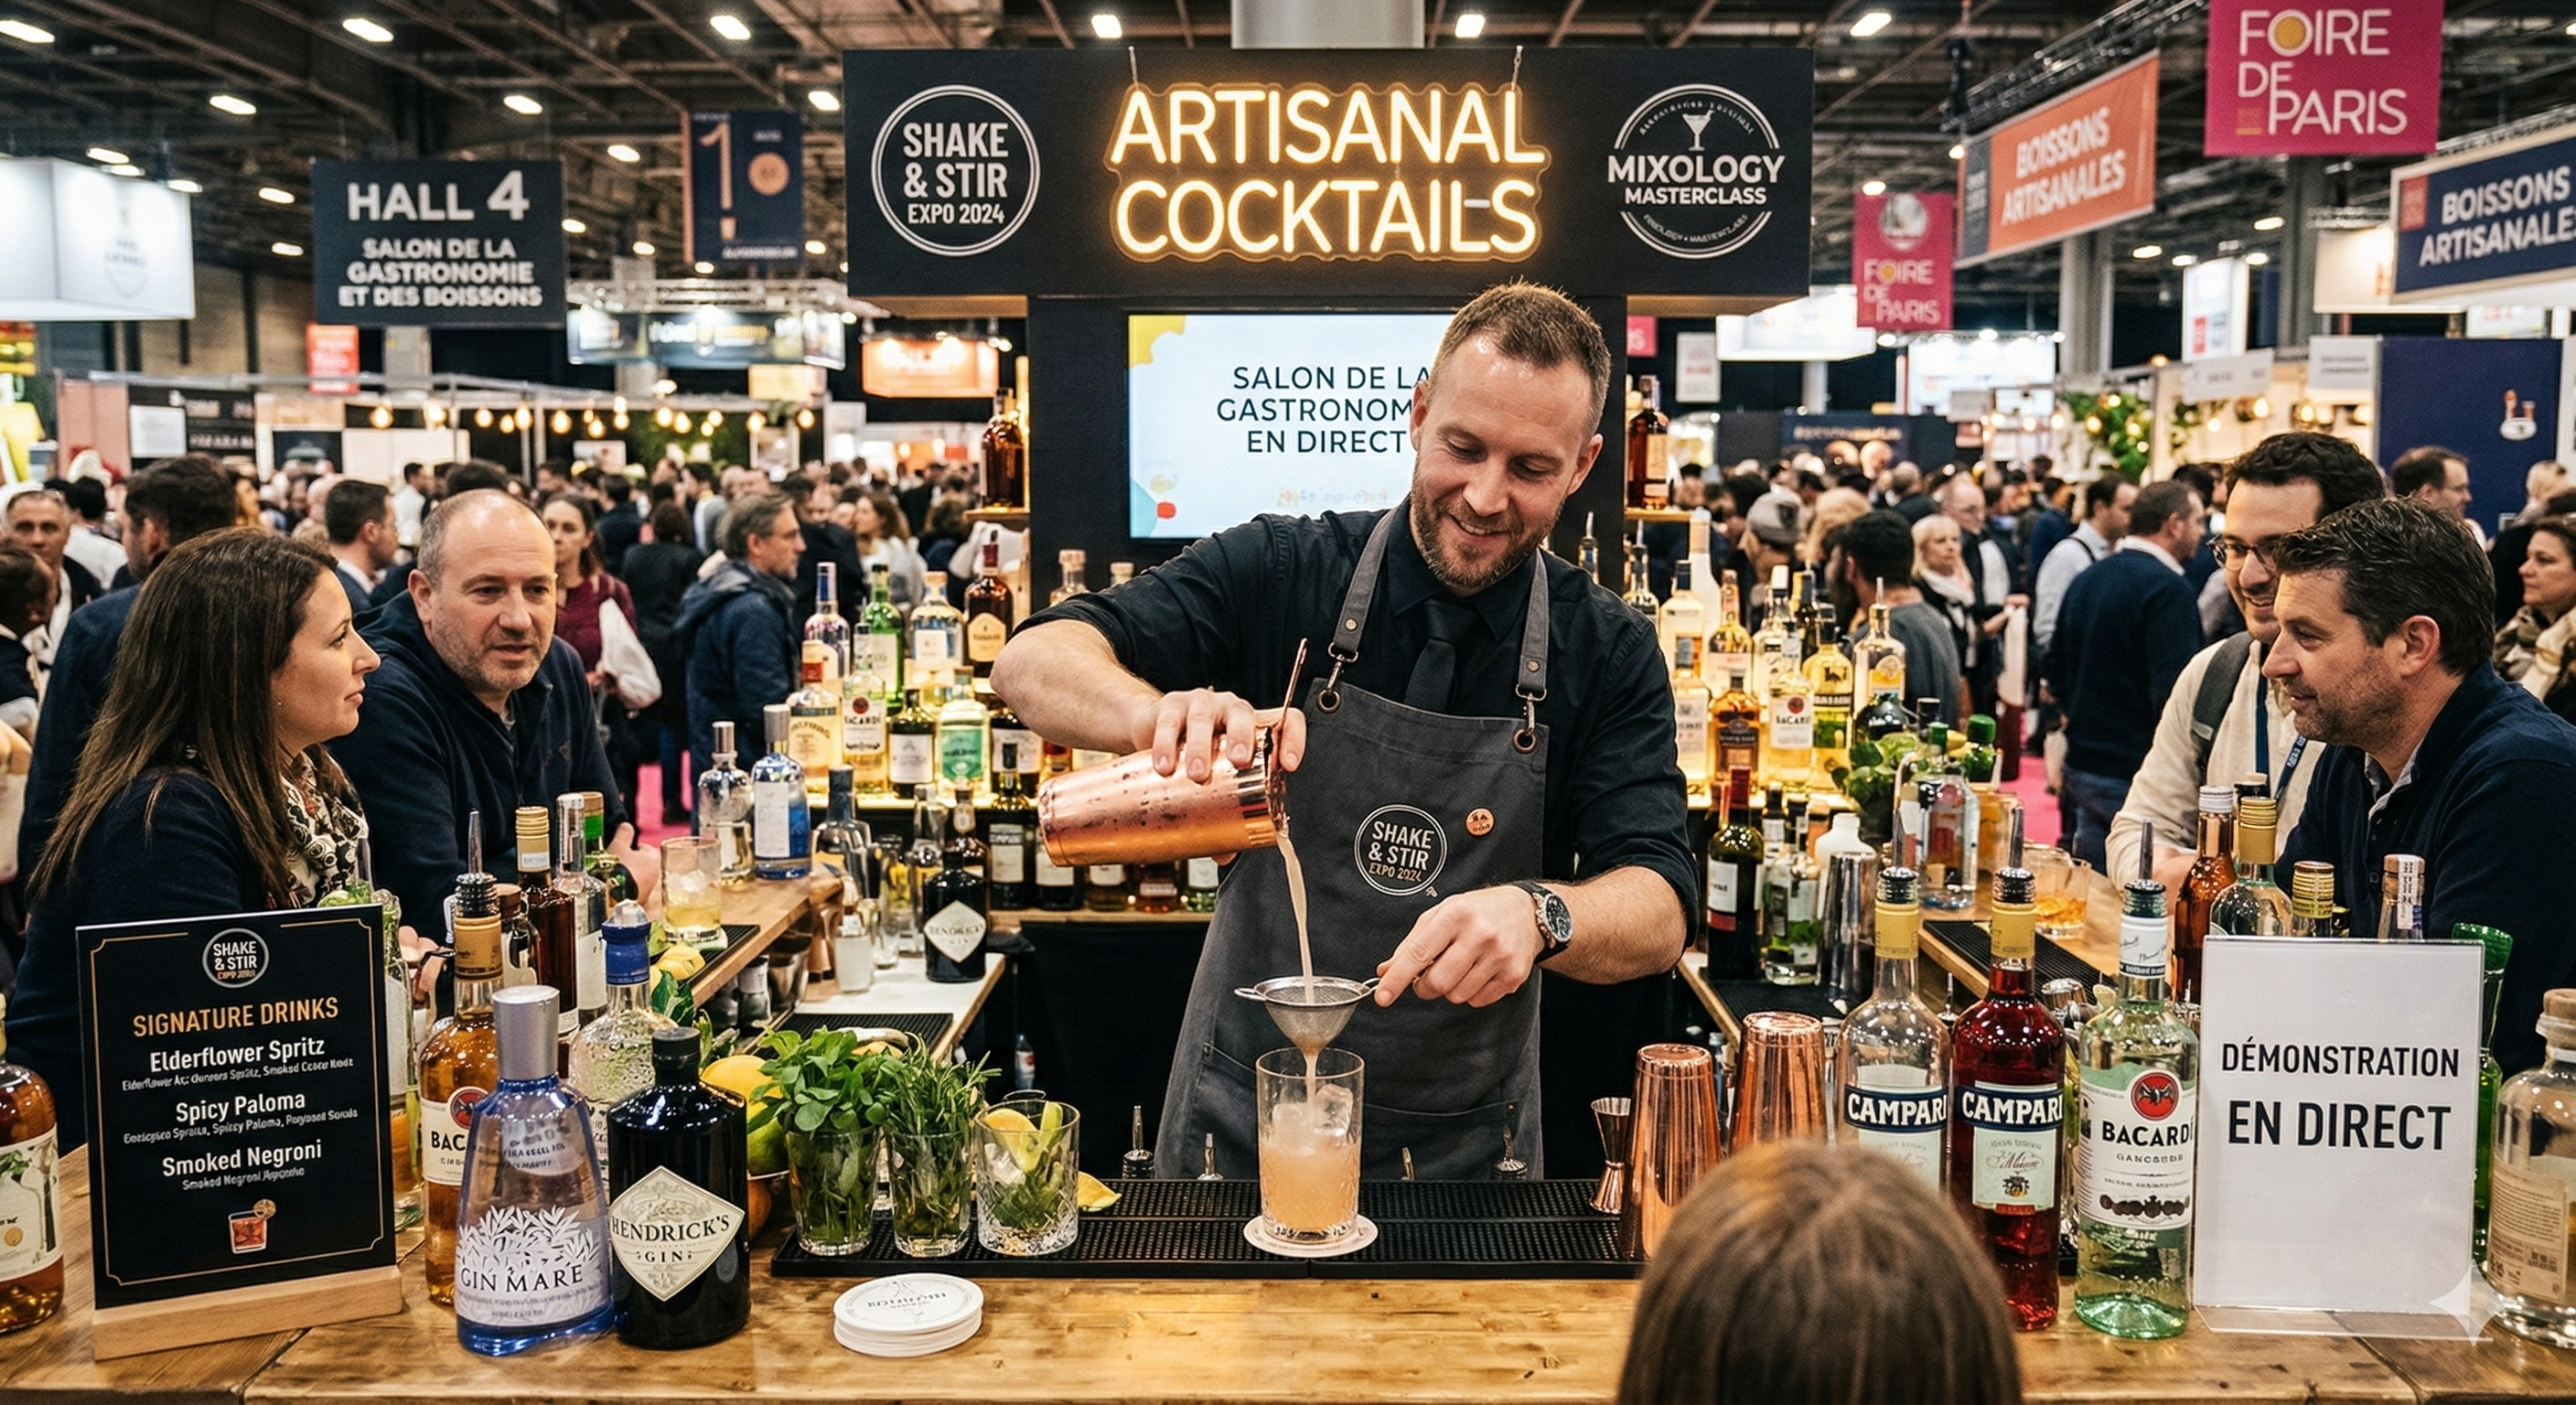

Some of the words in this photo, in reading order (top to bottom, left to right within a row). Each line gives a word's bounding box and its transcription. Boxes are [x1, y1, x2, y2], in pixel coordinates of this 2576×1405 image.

[2239, 9, 2391, 56] FOIRE
[2238, 61, 2294, 97] DE
[1111, 90, 1545, 164] ARTISANAL
[2269, 89, 2408, 135] PARIS
[903, 123, 1009, 157] SHAKE
[2016, 106, 2109, 178] BOISSONS
[903, 162, 928, 198] &
[936, 162, 1007, 198] STIR
[1608, 155, 1786, 183] MIXOLOGY
[348, 182, 475, 220] HALL
[486, 169, 531, 220] 4
[1625, 188, 1766, 205] MASTERCLASS
[2001, 148, 2126, 226] ARTISANALES
[2442, 166, 2571, 225] BOISSONS
[907, 203, 955, 224] EXPO
[959, 203, 1004, 224] 2024
[1116, 179, 1537, 253] COCKTAILS
[361, 238, 443, 259] SALON
[446, 238, 480, 259] DE
[484, 238, 517, 259] LA
[2419, 205, 2576, 266] ARTISANALE
[346, 262, 534, 284] GASTRONOMIE
[1863, 259, 1935, 284] FOIRE
[338, 285, 370, 306] ET
[373, 285, 420, 306] DES
[424, 285, 543, 307] BOISSONS
[1863, 283, 1888, 303] DE
[1876, 299, 1942, 325] PARIS
[1233, 366, 1335, 389] SALON
[1347, 367, 1385, 389] DE
[1218, 399, 1412, 421] GASTRONOM
[1248, 431, 1284, 453] EN
[1298, 430, 1407, 453] DIRECT
[1372, 820, 1435, 850] SHAKE
[1368, 842, 1383, 862] &
[1387, 845, 1429, 871] STIR
[213, 940, 257, 957] SHAKE
[214, 957, 225, 971] &
[227, 955, 257, 970] STIR
[133, 1004, 254, 1037] SIGNATURE
[260, 996, 338, 1025] DRINKS
[150, 1046, 264, 1073] Elderflower
[268, 1036, 326, 1064] Spritz
[2222, 1035, 2460, 1078] DÉMONSTRATION
[176, 1100, 230, 1125] Spicy
[234, 1093, 306, 1116] Paloma
[2228, 1100, 2281, 1145] EN
[2297, 1102, 2452, 1151] DIRECT
[162, 1149, 242, 1177] Smoked
[248, 1139, 321, 1168] Negroni
[612, 1215, 729, 1241] HENDRICK'S
[461, 1268, 497, 1292] GIN
[506, 1264, 583, 1292] MARE
